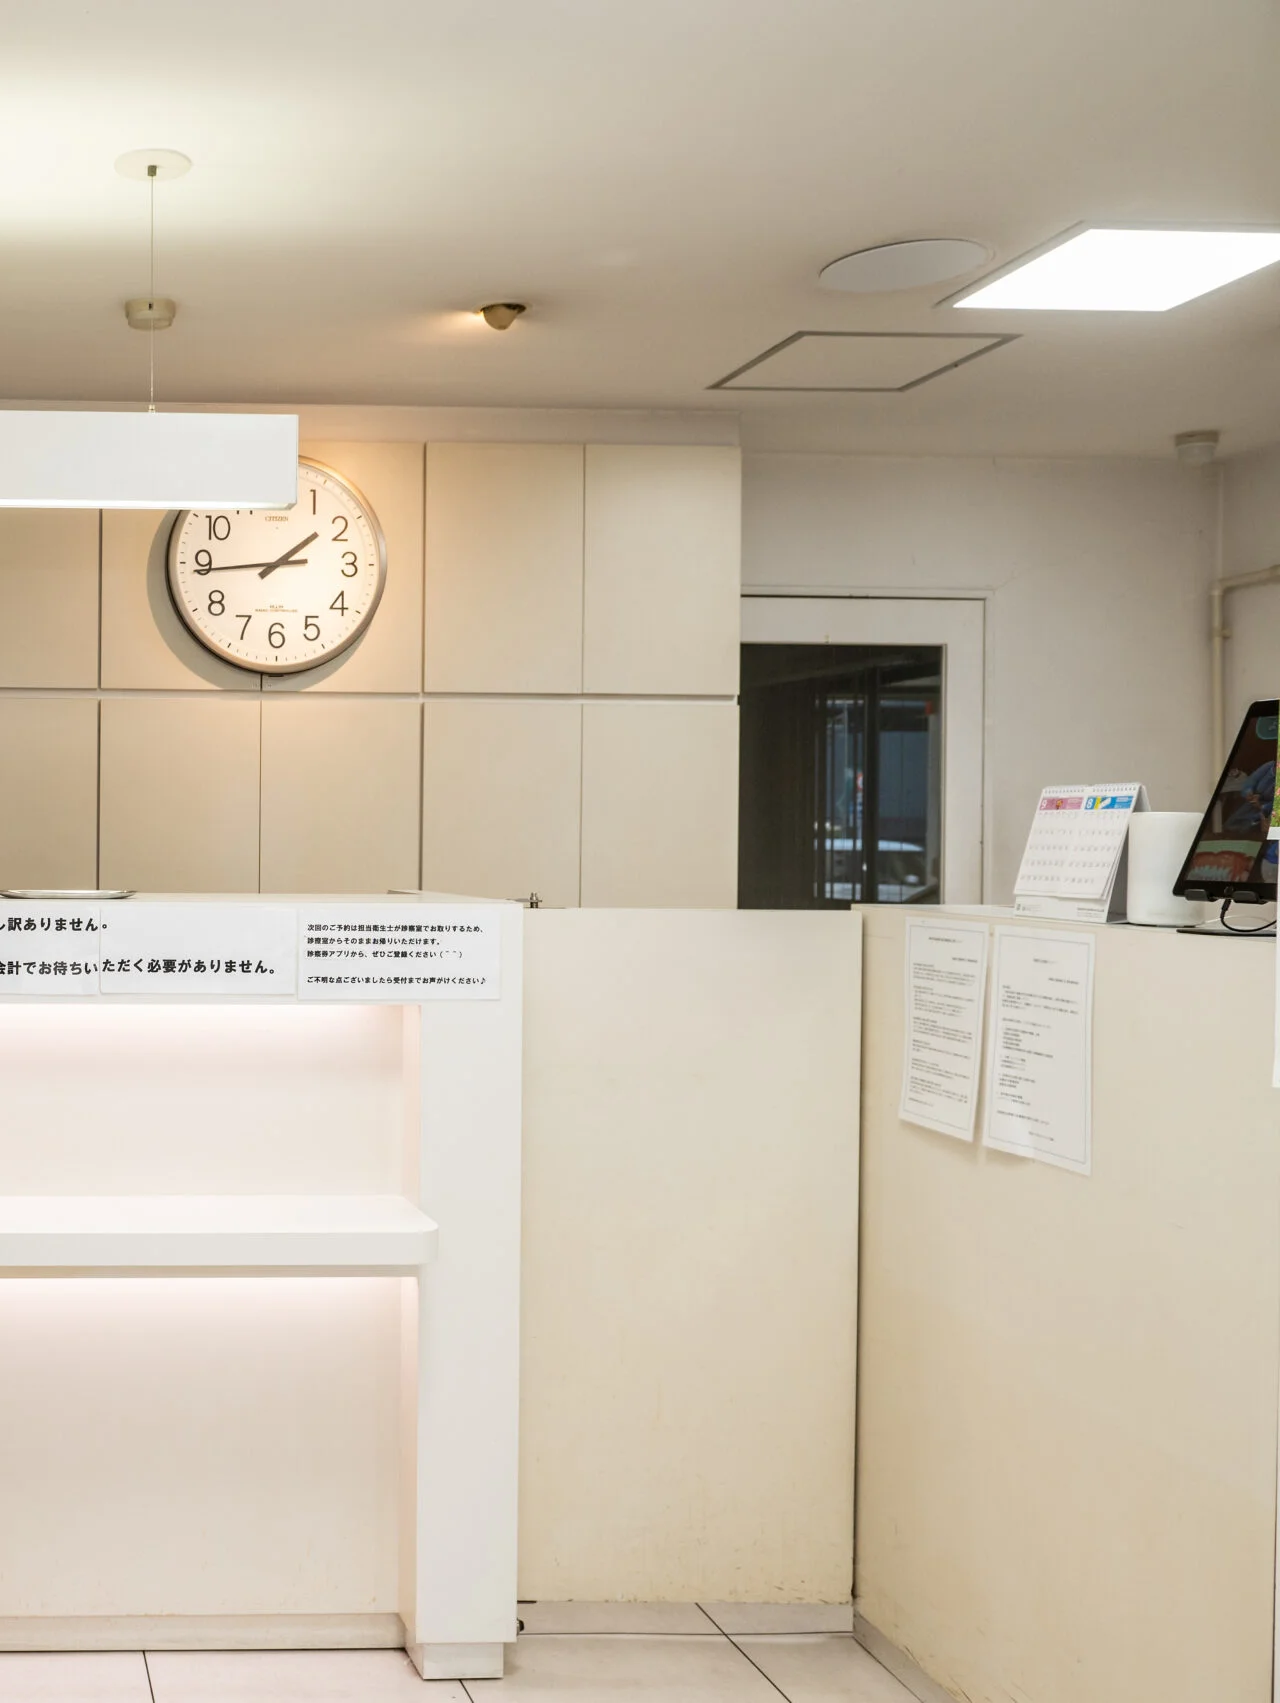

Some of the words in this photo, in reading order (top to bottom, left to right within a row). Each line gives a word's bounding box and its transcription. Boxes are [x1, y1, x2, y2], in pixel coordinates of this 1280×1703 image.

[310, 489, 317, 515] 1
[206, 515, 231, 541] 10
[331, 516, 348, 542] 2
[194, 549, 213, 575] 9
[341, 552, 358, 578] 3
[208, 590, 225, 616] 8
[329, 591, 348, 616] 4
[235, 615, 253, 640] 7
[268, 622, 285, 649] 6
[303, 615, 321, 641] 5
